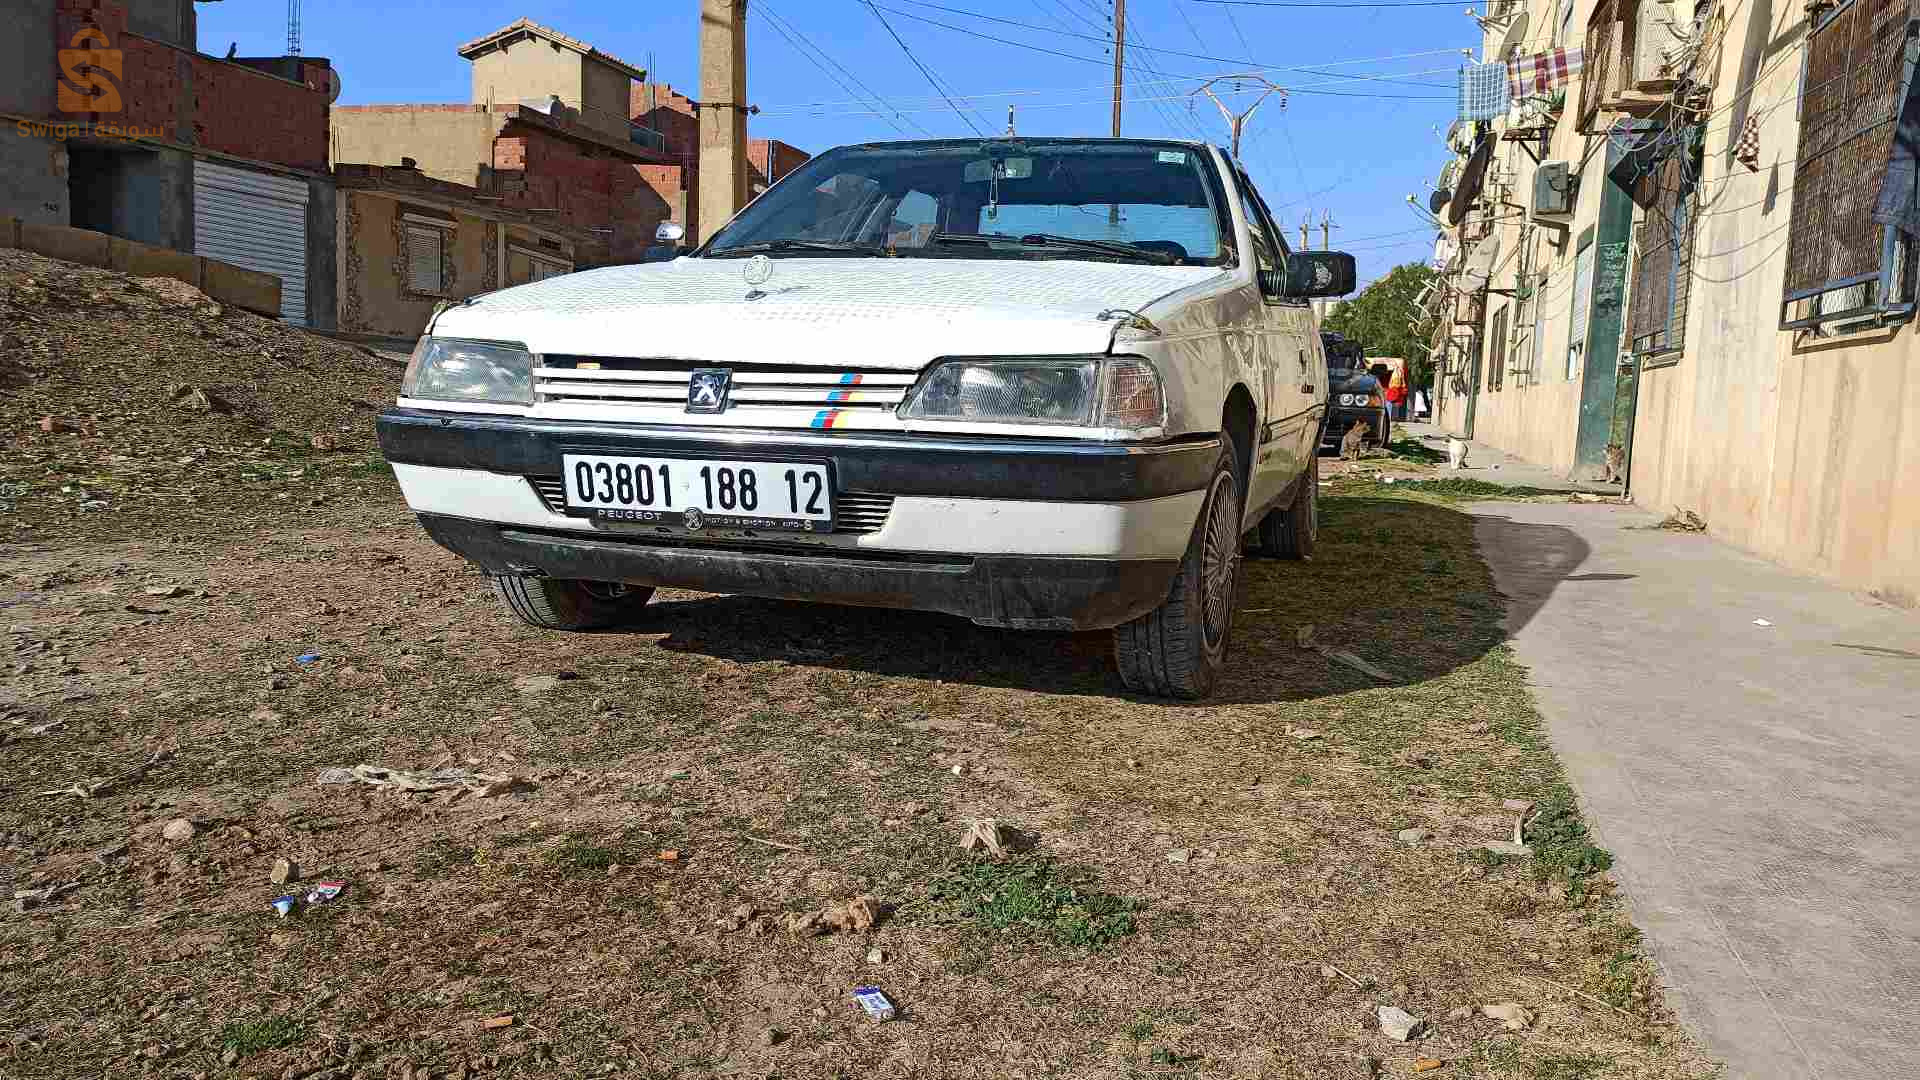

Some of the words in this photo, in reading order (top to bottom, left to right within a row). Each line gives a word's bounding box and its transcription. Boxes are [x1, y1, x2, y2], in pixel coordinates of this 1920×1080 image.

[575, 461, 671, 507] 03801
[700, 466, 757, 511] 188
[785, 469, 824, 514] 12
[598, 509, 662, 520] PEUGEOT
